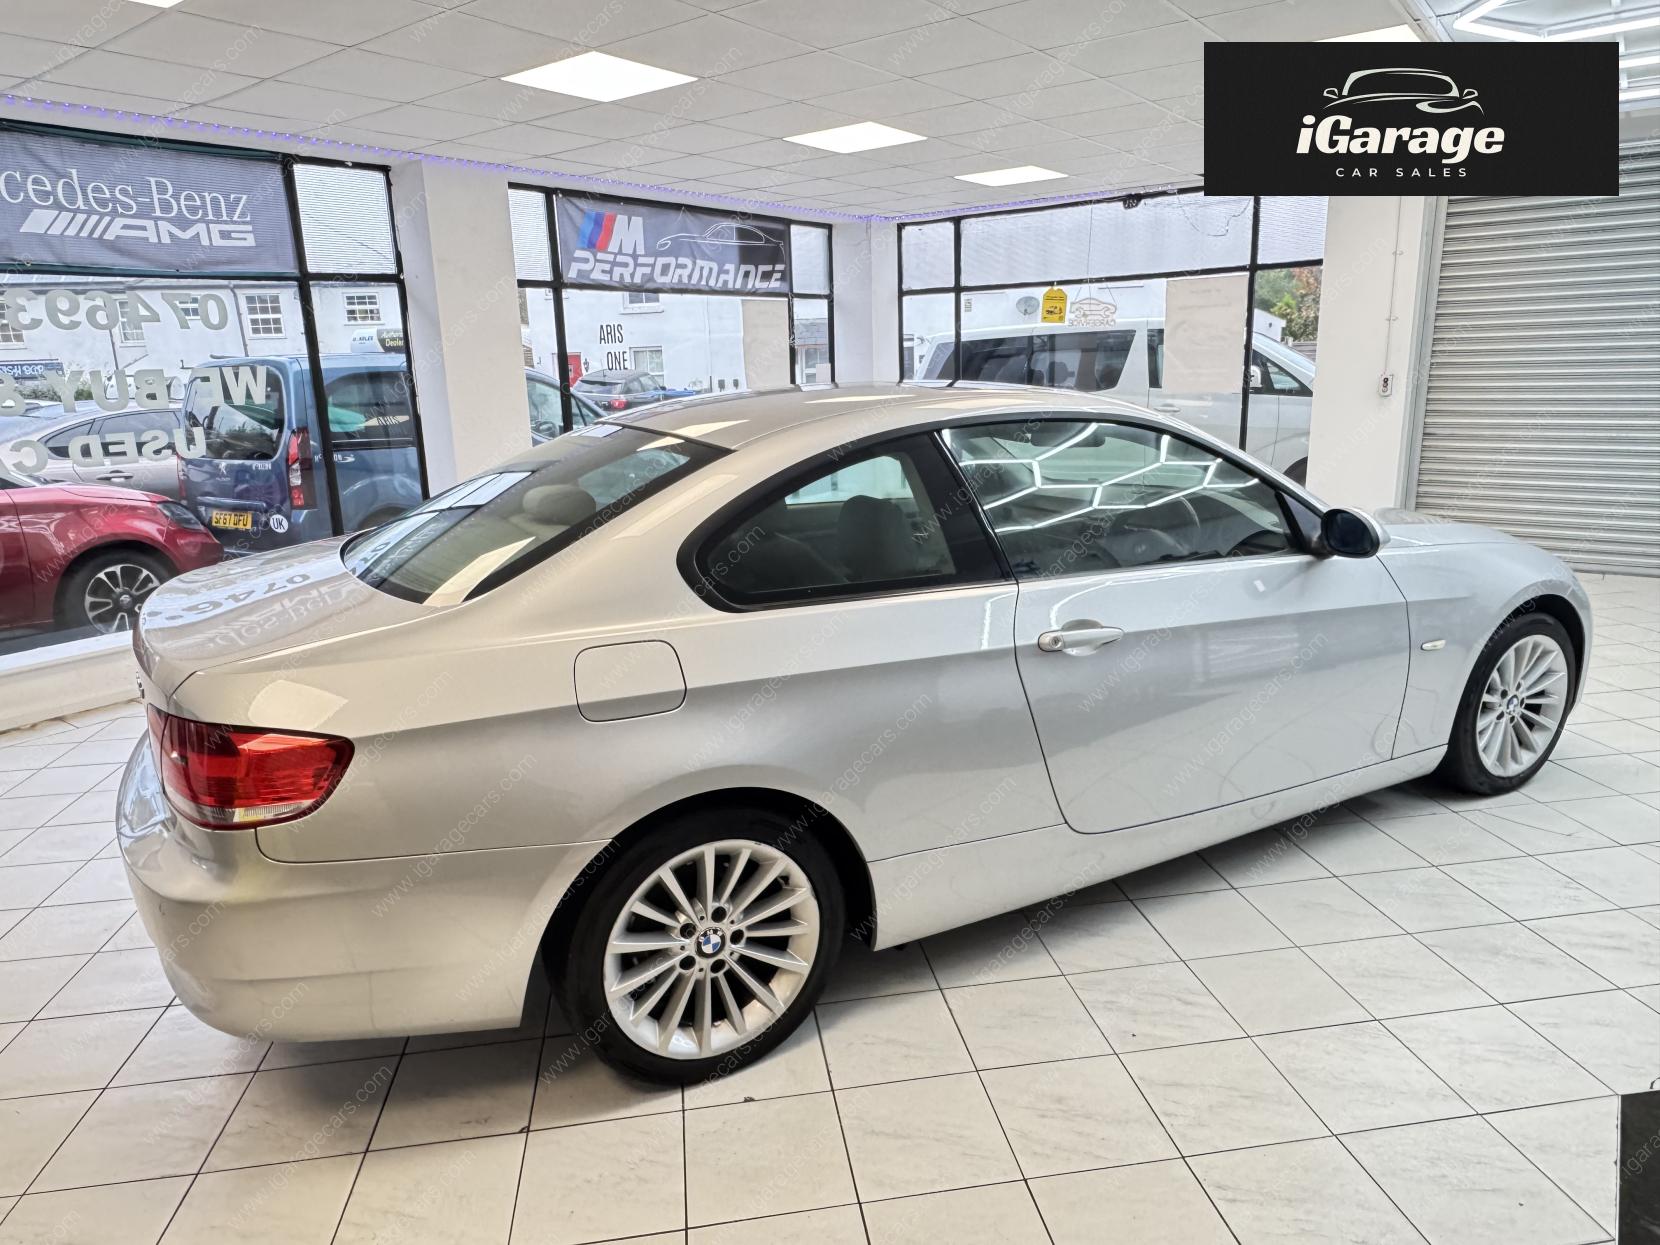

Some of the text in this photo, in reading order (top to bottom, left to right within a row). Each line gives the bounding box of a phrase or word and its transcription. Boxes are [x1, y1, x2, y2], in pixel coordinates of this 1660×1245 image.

[103, 216, 257, 247] AMG
[567, 249, 786, 289] PERFORMANCE
[599, 323, 624, 345] ARIS
[606, 351, 628, 371] ONE
[272, 517, 285, 531] UK
